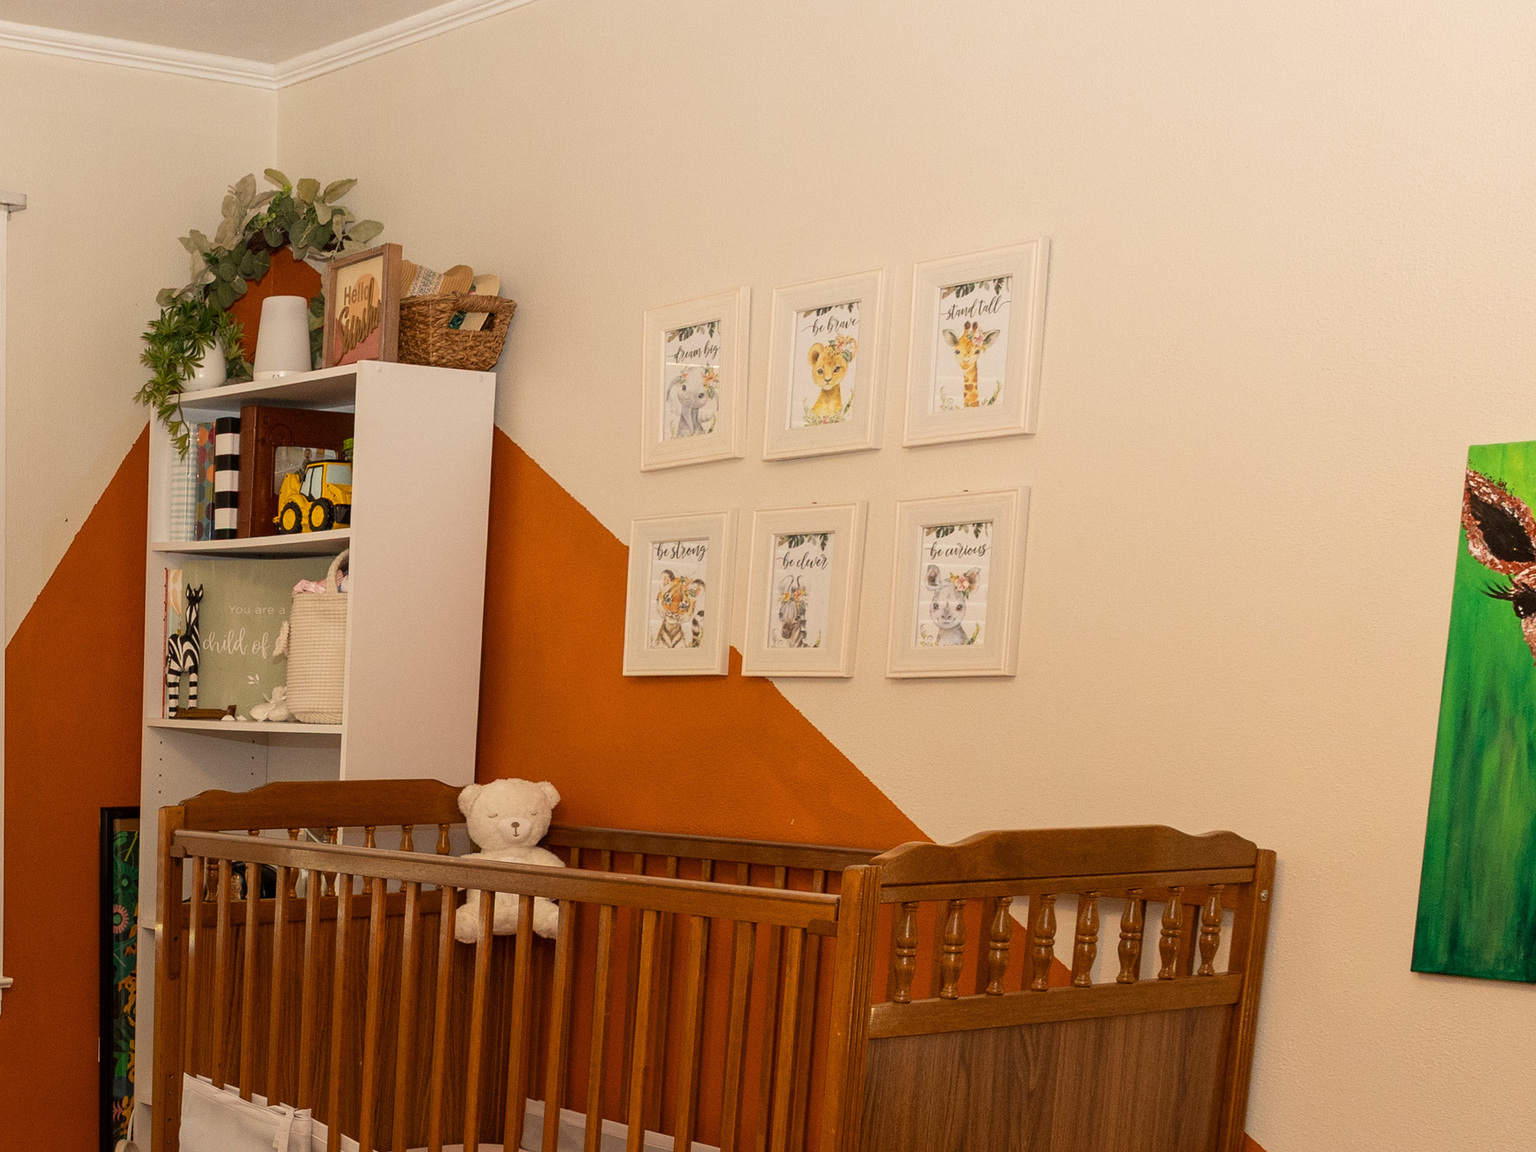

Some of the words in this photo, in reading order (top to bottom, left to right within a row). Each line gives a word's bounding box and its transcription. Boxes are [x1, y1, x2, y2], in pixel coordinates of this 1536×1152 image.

[344, 282, 369, 306] Hello
[942, 299, 978, 320] stand
[978, 295, 1011, 315] tall
[827, 316, 860, 333] brave
[669, 345, 702, 363] dream
[703, 340, 720, 360] big
[655, 542, 669, 560] be
[670, 541, 708, 562] strong
[777, 551, 795, 570] be
[796, 551, 829, 570] clever
[927, 541, 943, 560] be
[945, 542, 990, 559] curious
[228, 604, 251, 615] You
[254, 606, 275, 615] are
[278, 606, 286, 615] a
[202, 627, 249, 656] child
[251, 632, 270, 659] of
